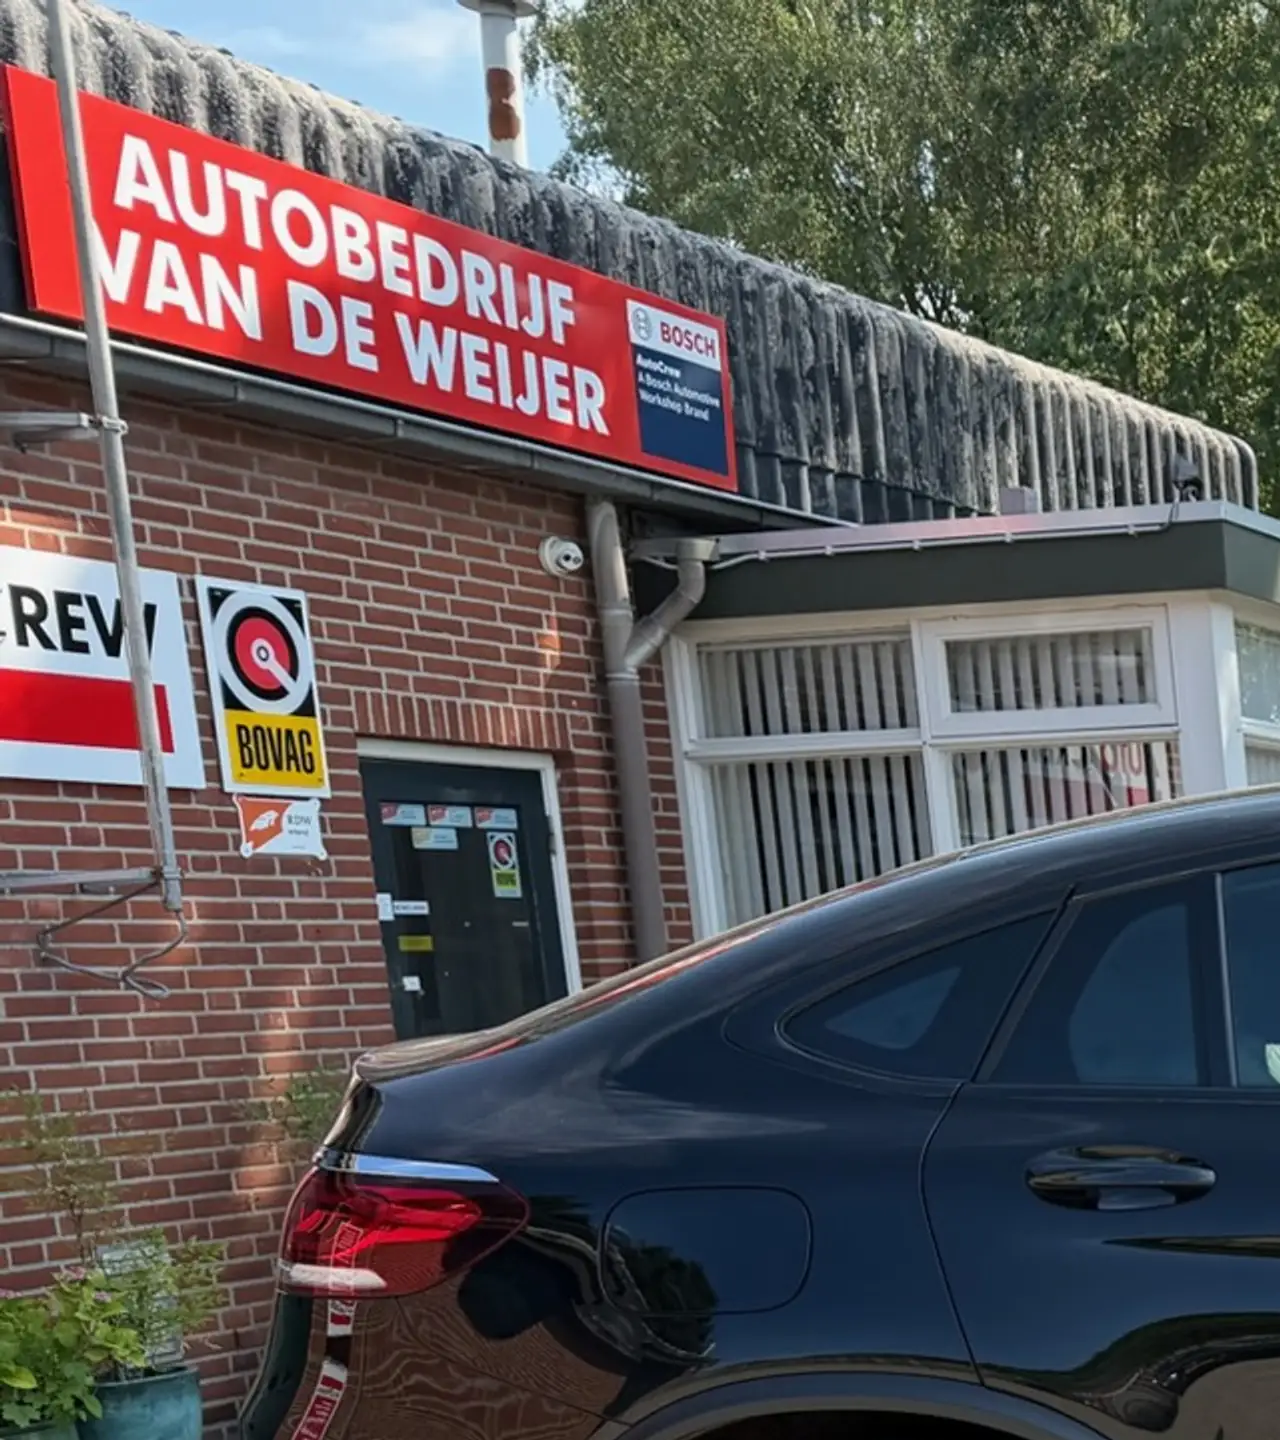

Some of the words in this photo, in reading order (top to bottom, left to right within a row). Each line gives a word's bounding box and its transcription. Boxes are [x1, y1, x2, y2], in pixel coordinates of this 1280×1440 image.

[113, 133, 577, 347] AUTOBEDRIJF
[92, 222, 262, 341] VAN
[286, 279, 379, 373] DE
[395, 312, 610, 436] WEIJER
[661, 323, 715, 357] BOSCH
[0, 583, 157, 660] REW
[236, 724, 316, 774] BOVAG
